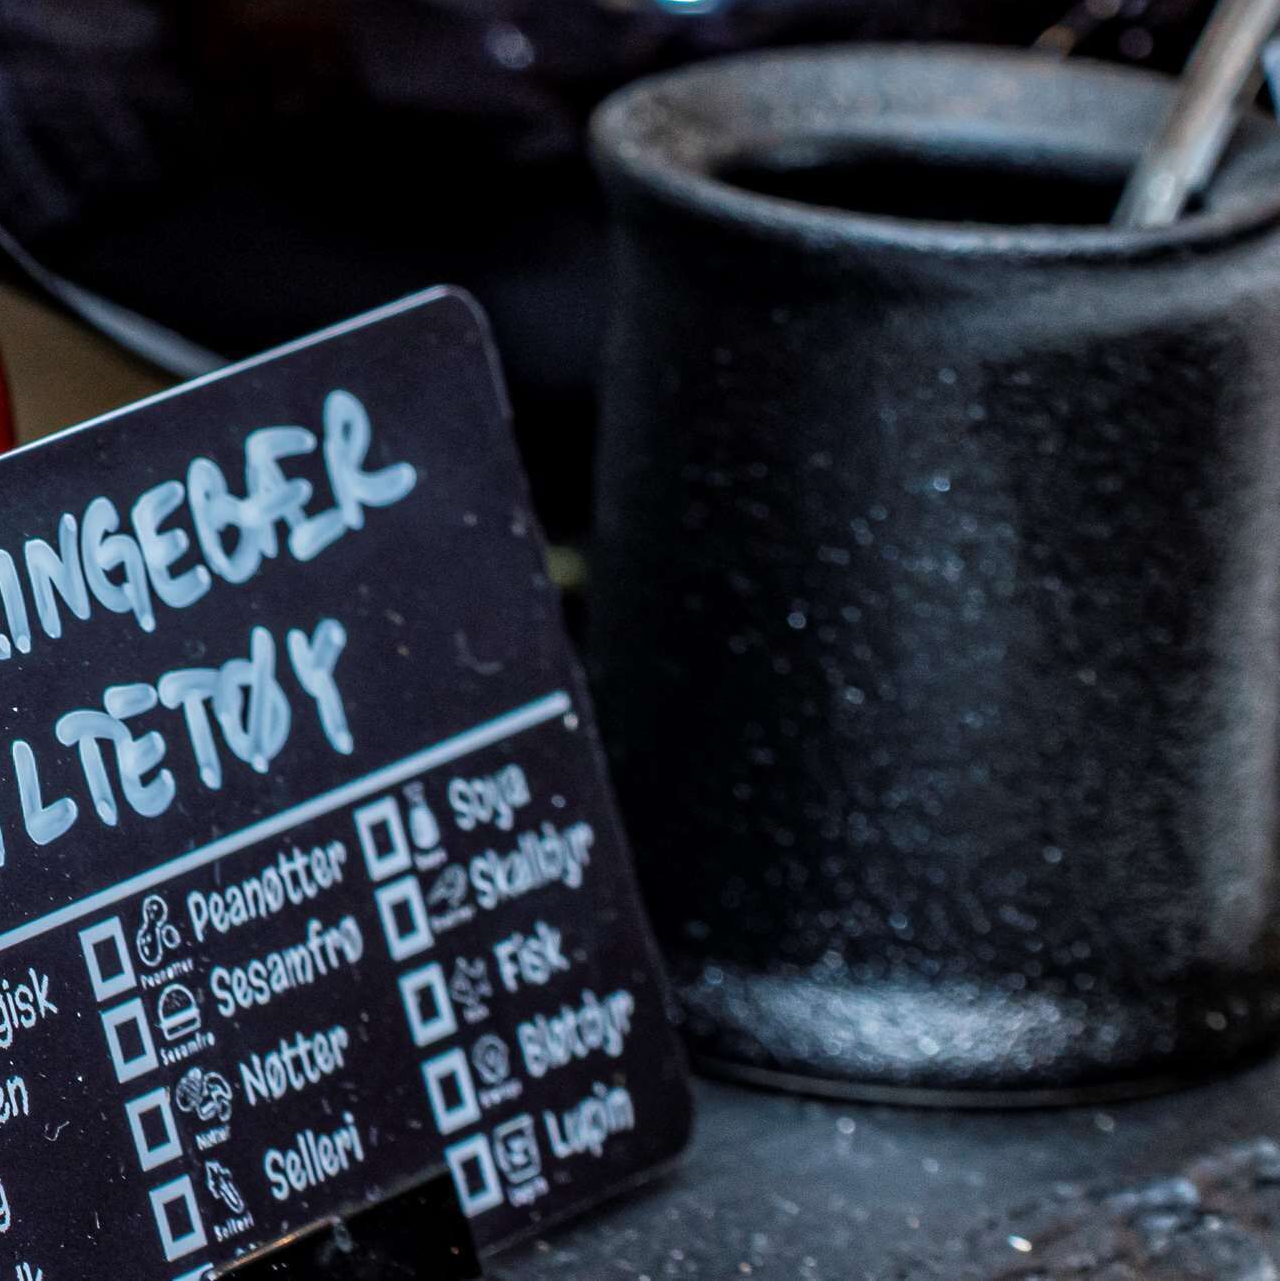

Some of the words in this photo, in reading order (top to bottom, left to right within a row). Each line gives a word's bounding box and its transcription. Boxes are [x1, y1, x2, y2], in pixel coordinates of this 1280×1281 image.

[448, 764, 531, 830] Soya
[187, 841, 347, 942] Peanøtter
[210, 916, 363, 1017] Sesamfrø
[239, 1025, 349, 1106] Nøtter
[264, 1112, 365, 1200] Selleri
